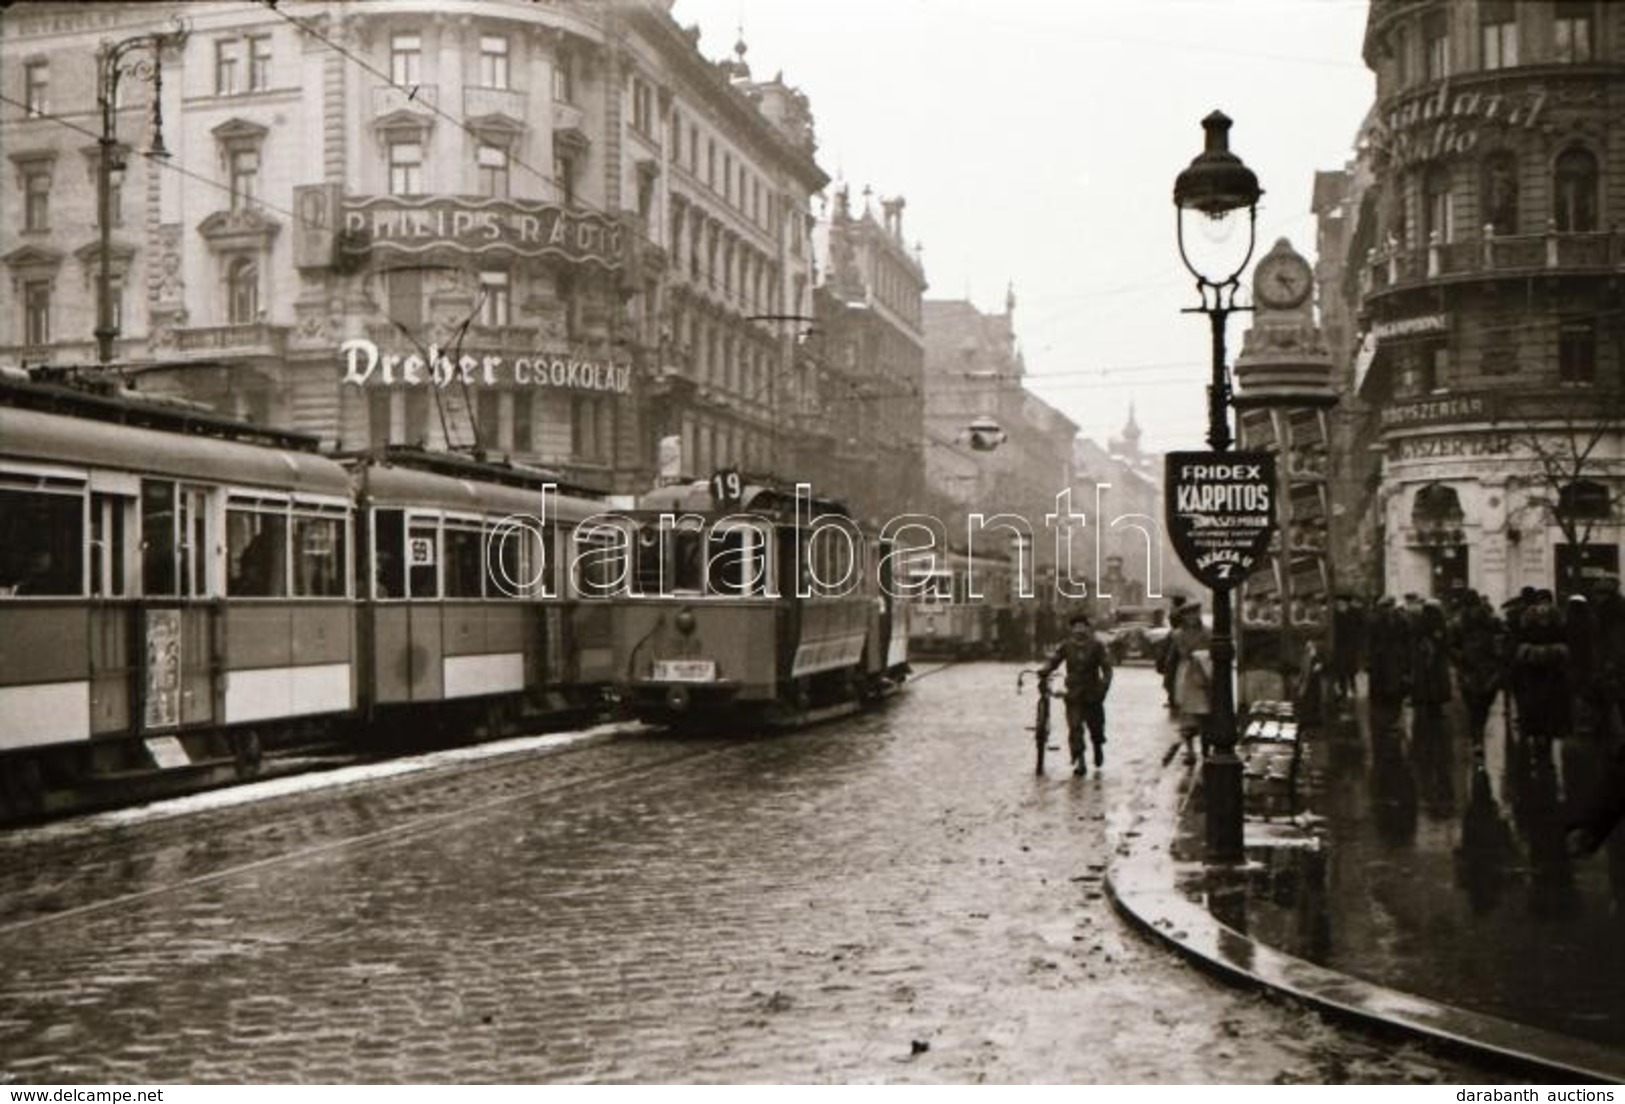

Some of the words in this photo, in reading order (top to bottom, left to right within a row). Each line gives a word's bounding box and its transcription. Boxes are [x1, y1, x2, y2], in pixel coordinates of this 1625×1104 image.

[345, 209, 501, 239] PHILIPS
[341, 338, 502, 387] Dreher
[714, 472, 741, 501] 19
[1181, 464, 1260, 480] FRIDEX
[1217, 564, 1232, 579] 7
